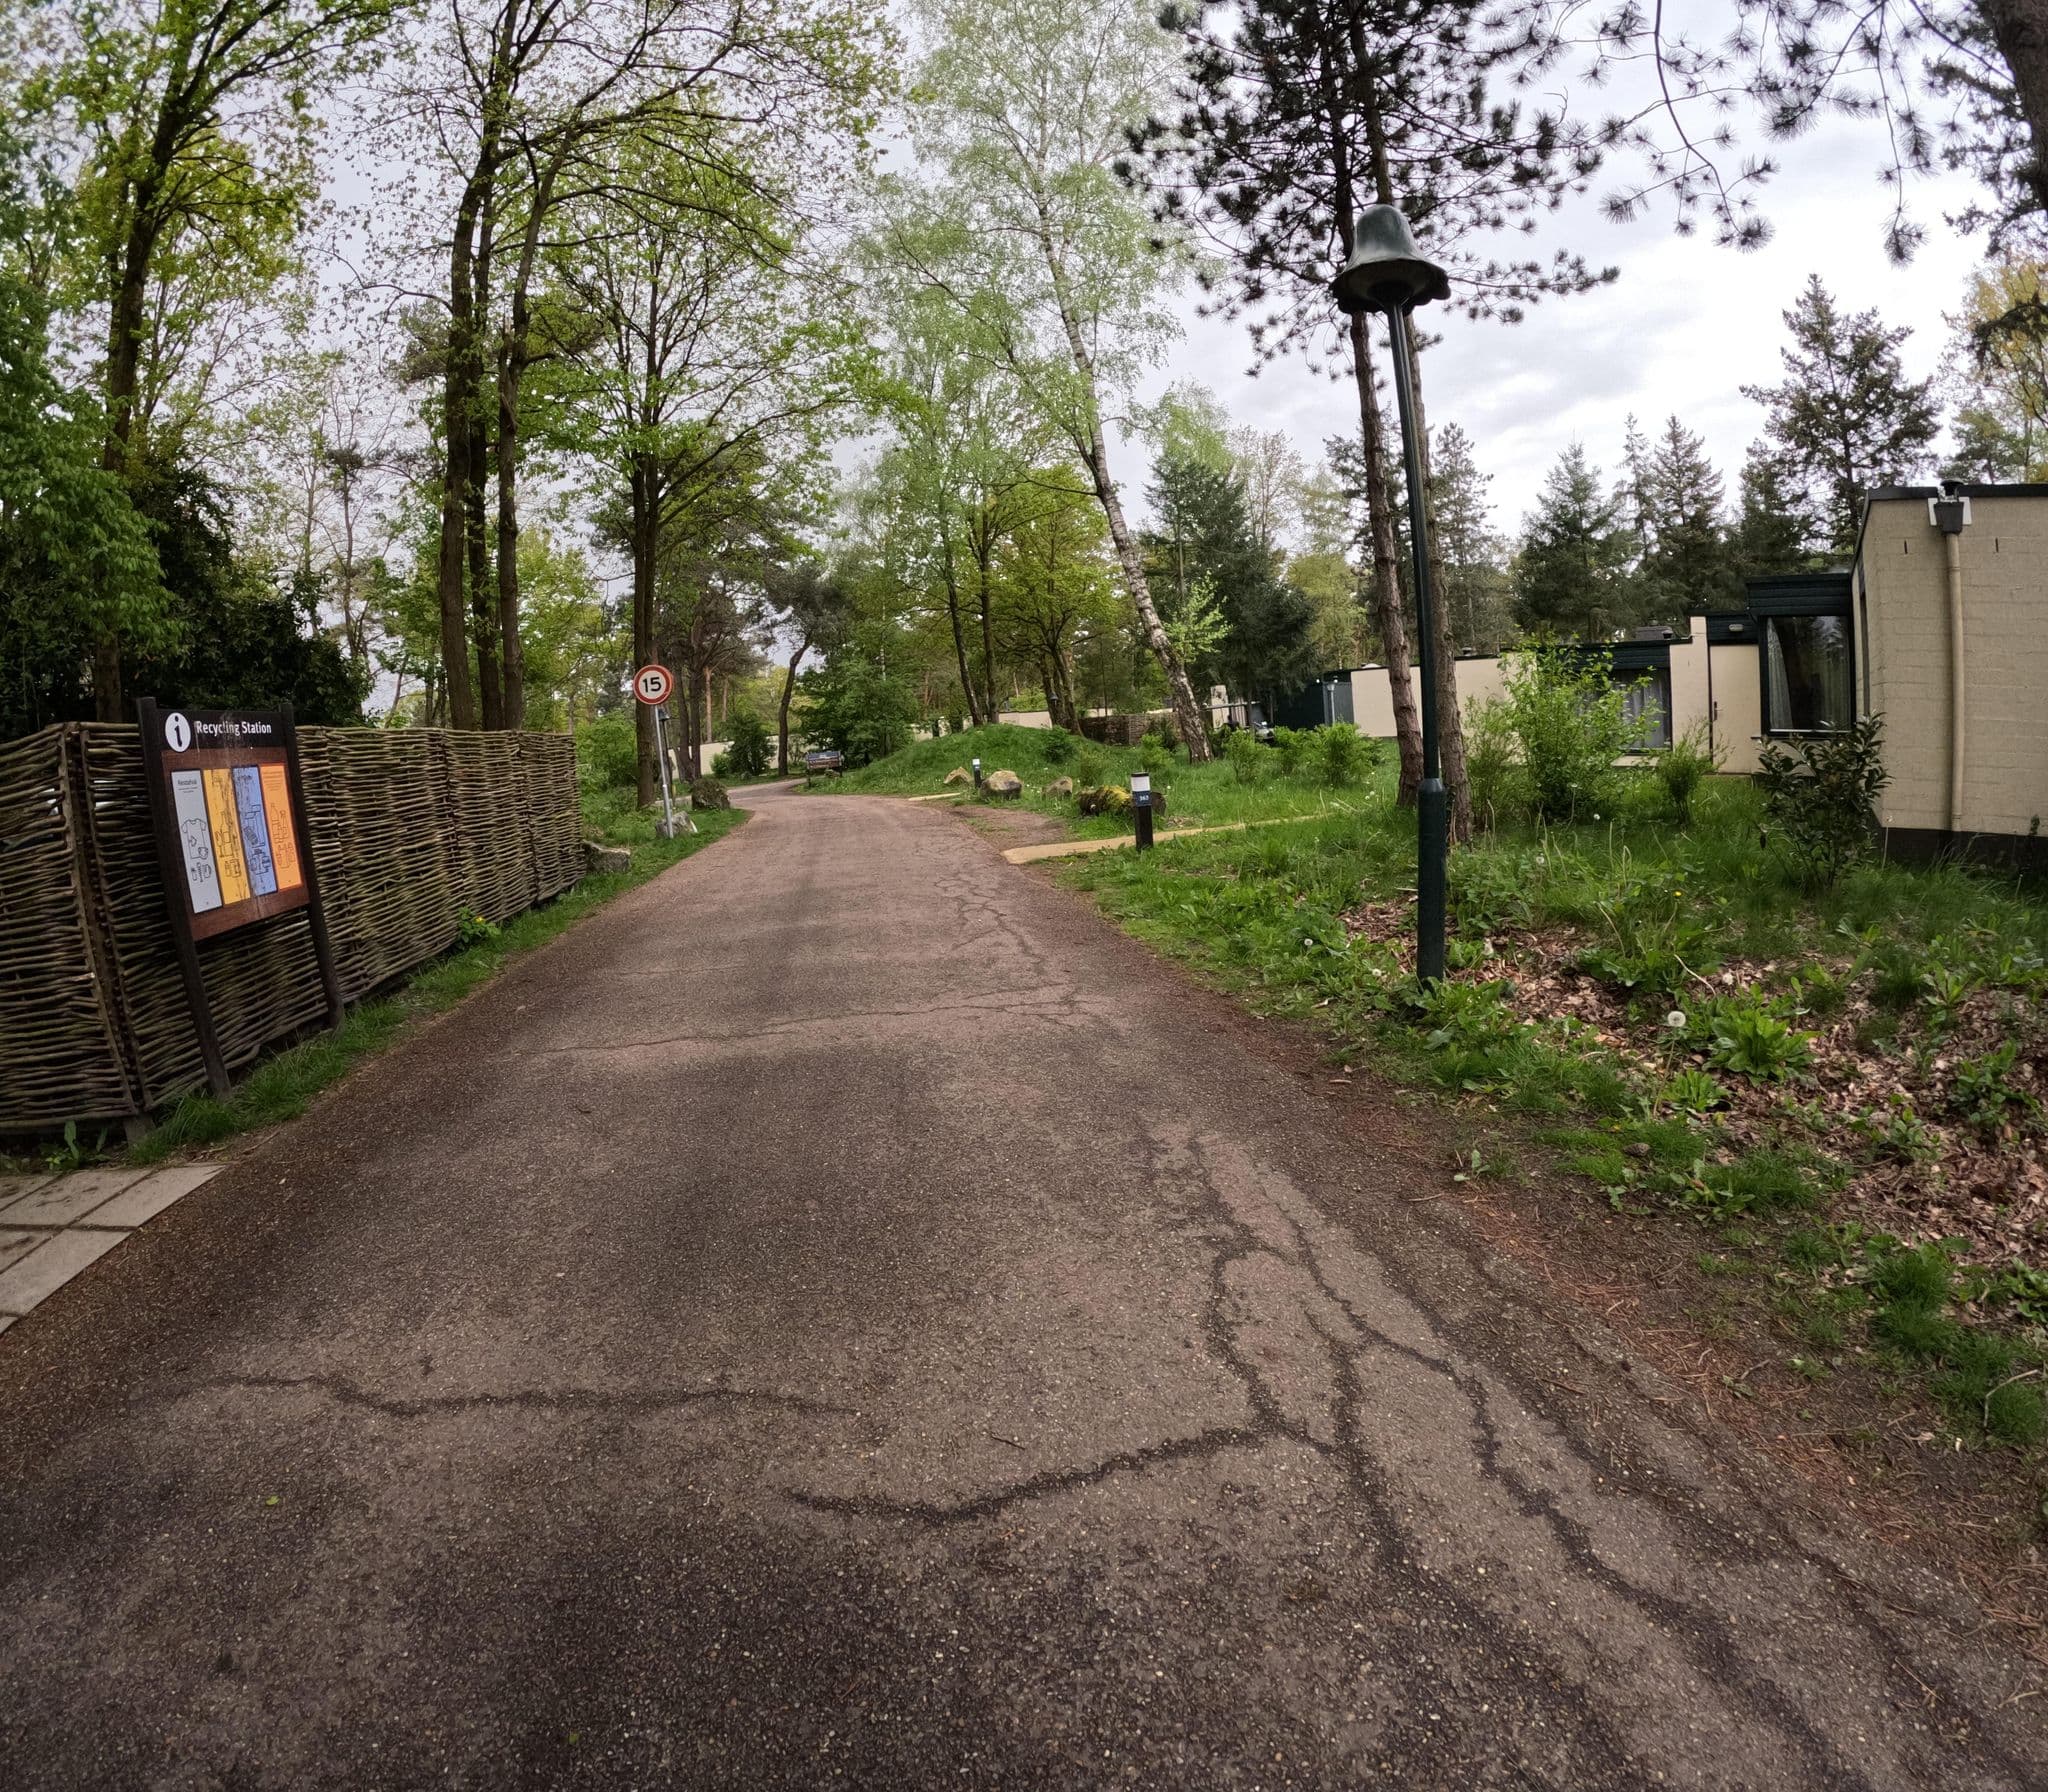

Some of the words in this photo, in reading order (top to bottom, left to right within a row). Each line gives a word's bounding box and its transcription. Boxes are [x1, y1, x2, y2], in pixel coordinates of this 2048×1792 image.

[643, 677, 661, 693] 15
[196, 720, 240, 736] Recycling
[241, 721, 272, 734] Station
